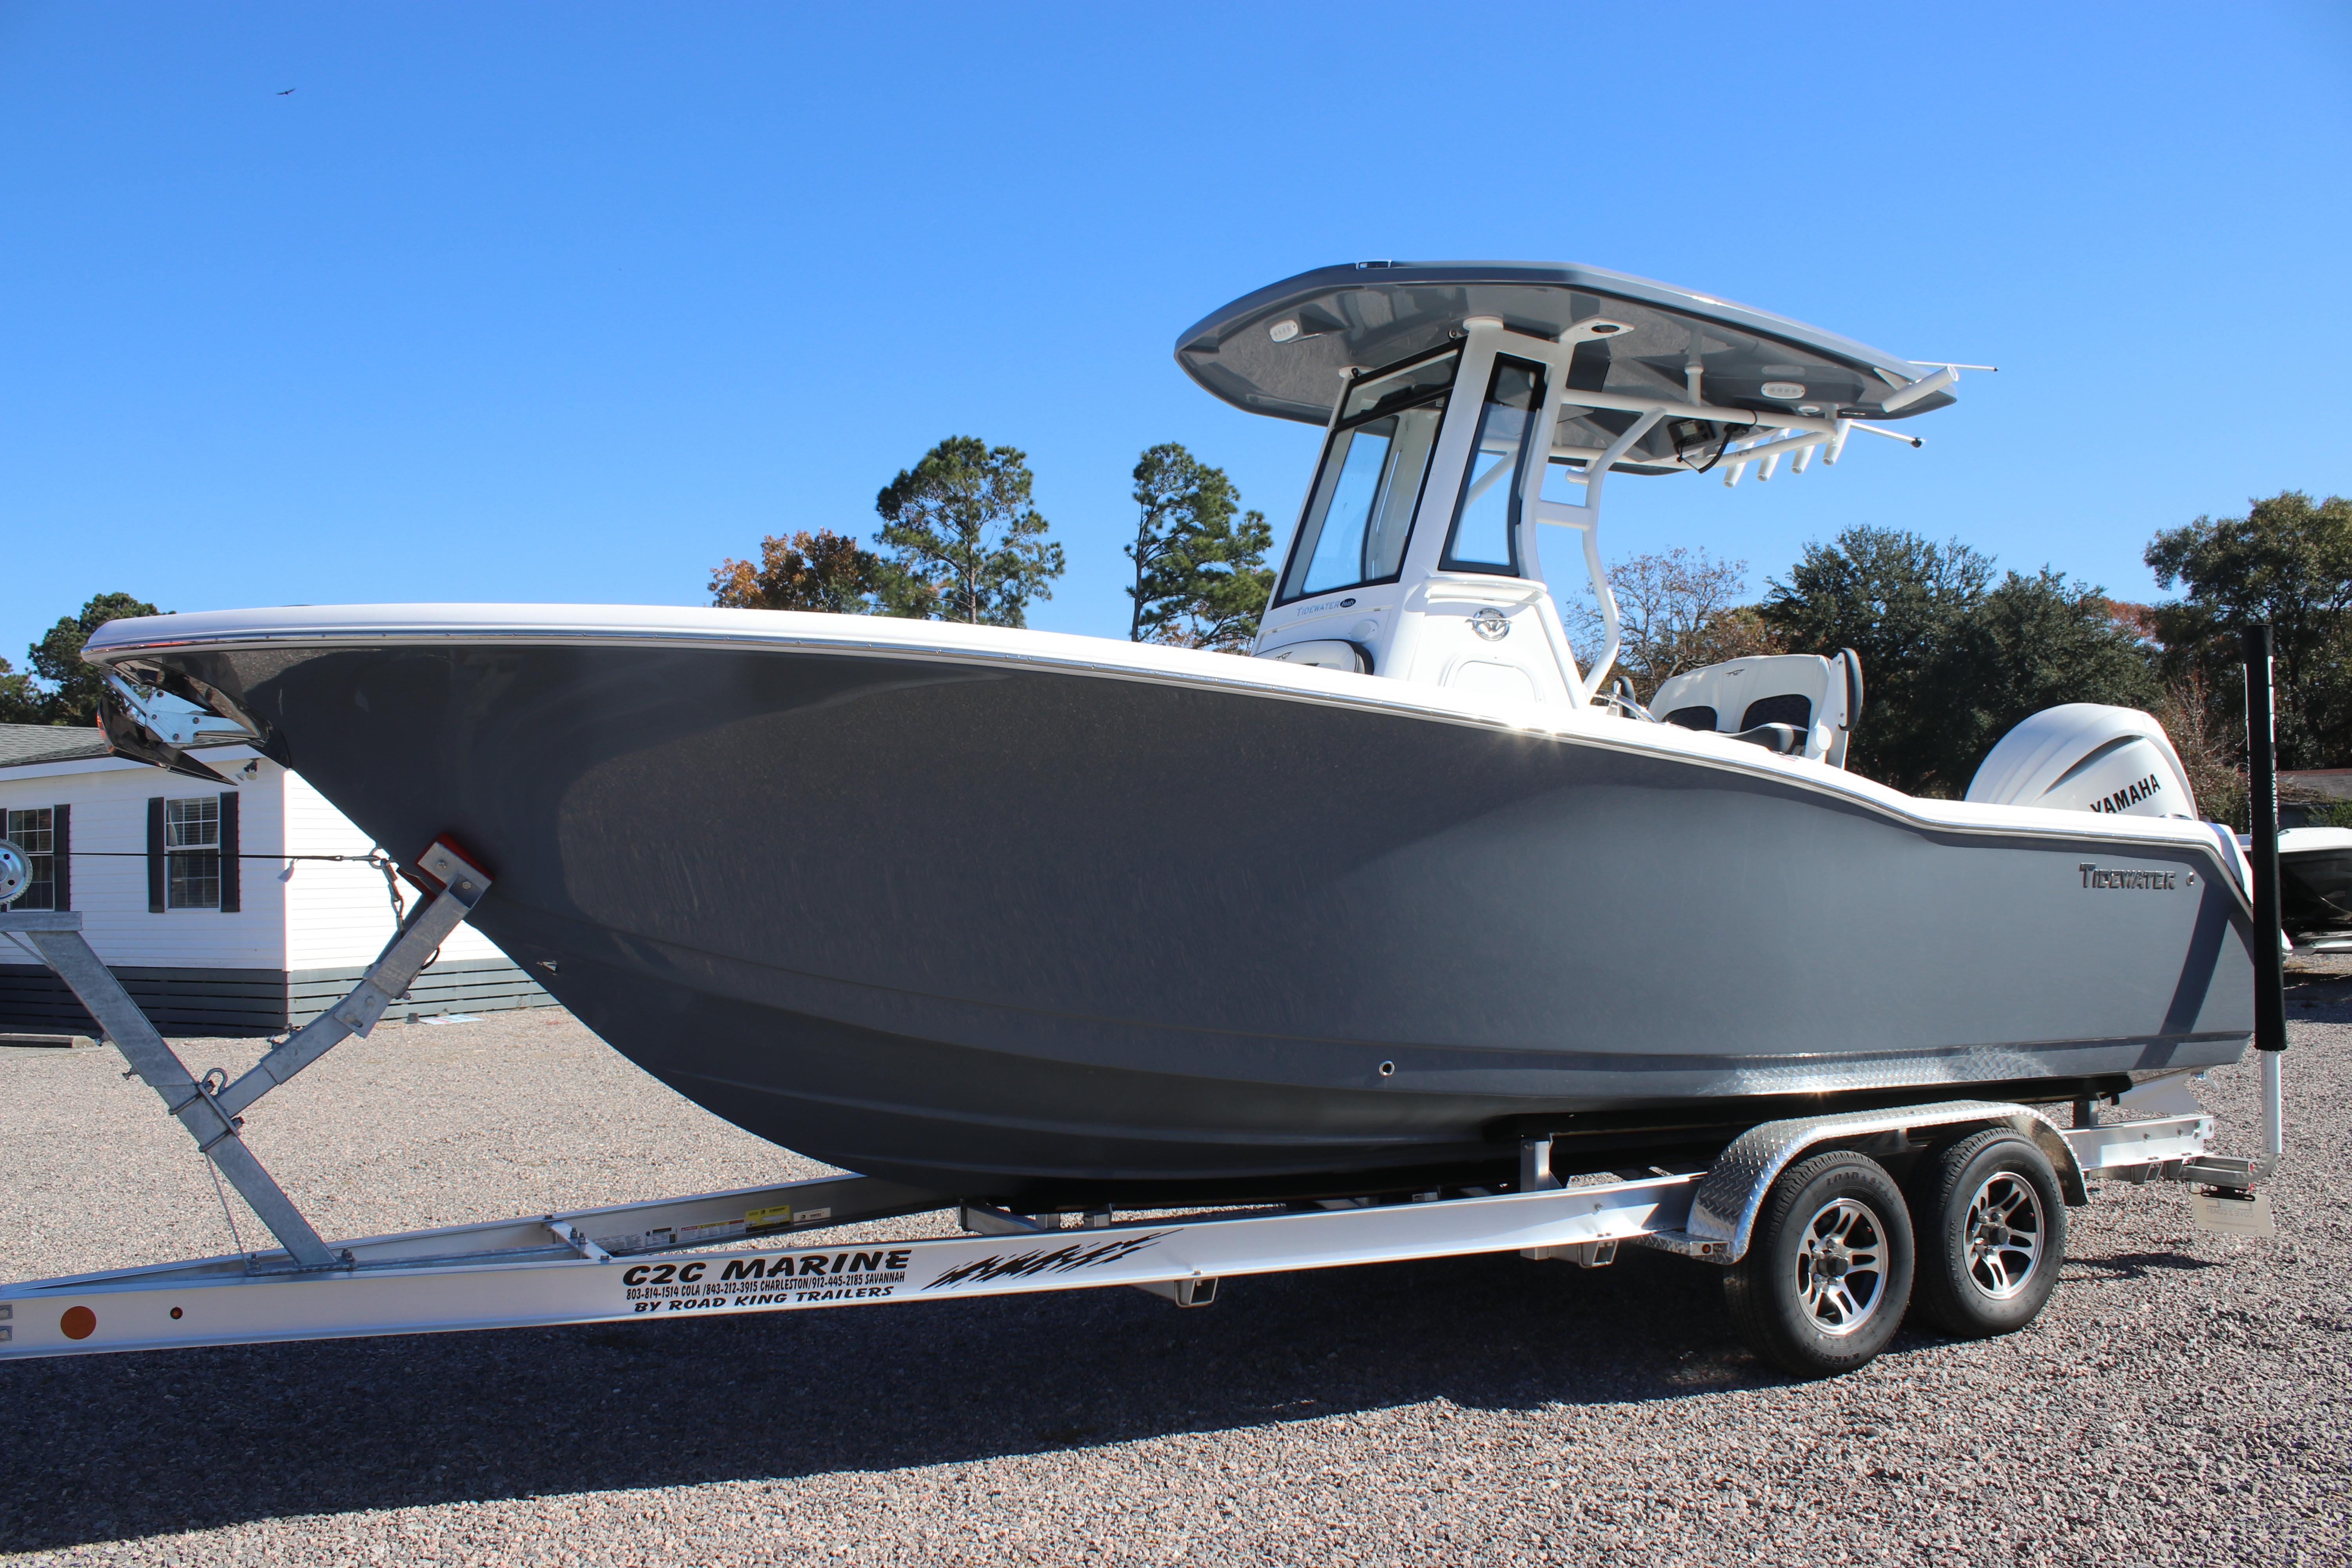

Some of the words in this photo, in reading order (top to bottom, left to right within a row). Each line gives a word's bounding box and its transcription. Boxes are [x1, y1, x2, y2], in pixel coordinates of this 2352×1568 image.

[1297, 601, 1341, 616] TIDEWATER
[2090, 773, 2161, 814] YAMAHA
[2079, 863, 2176, 889] TIDEWATER
[1826, 1171, 1859, 1186] LOAD
[622, 1262, 706, 1286] C2C
[720, 1250, 912, 1280] MARINE
[626, 1285, 679, 1300] 803-814-1514
[681, 1284, 700, 1297] COLA
[702, 1280, 758, 1296] /843-212-3915
[760, 1273, 863, 1292] CHARLESTON/912-445-2185
[865, 1271, 905, 1285] SAVANNAH
[634, 1301, 662, 1312] BY
[669, 1298, 726, 1310] ROAD
[734, 1293, 787, 1306] KING
[796, 1286, 894, 1301] TRAILERS
